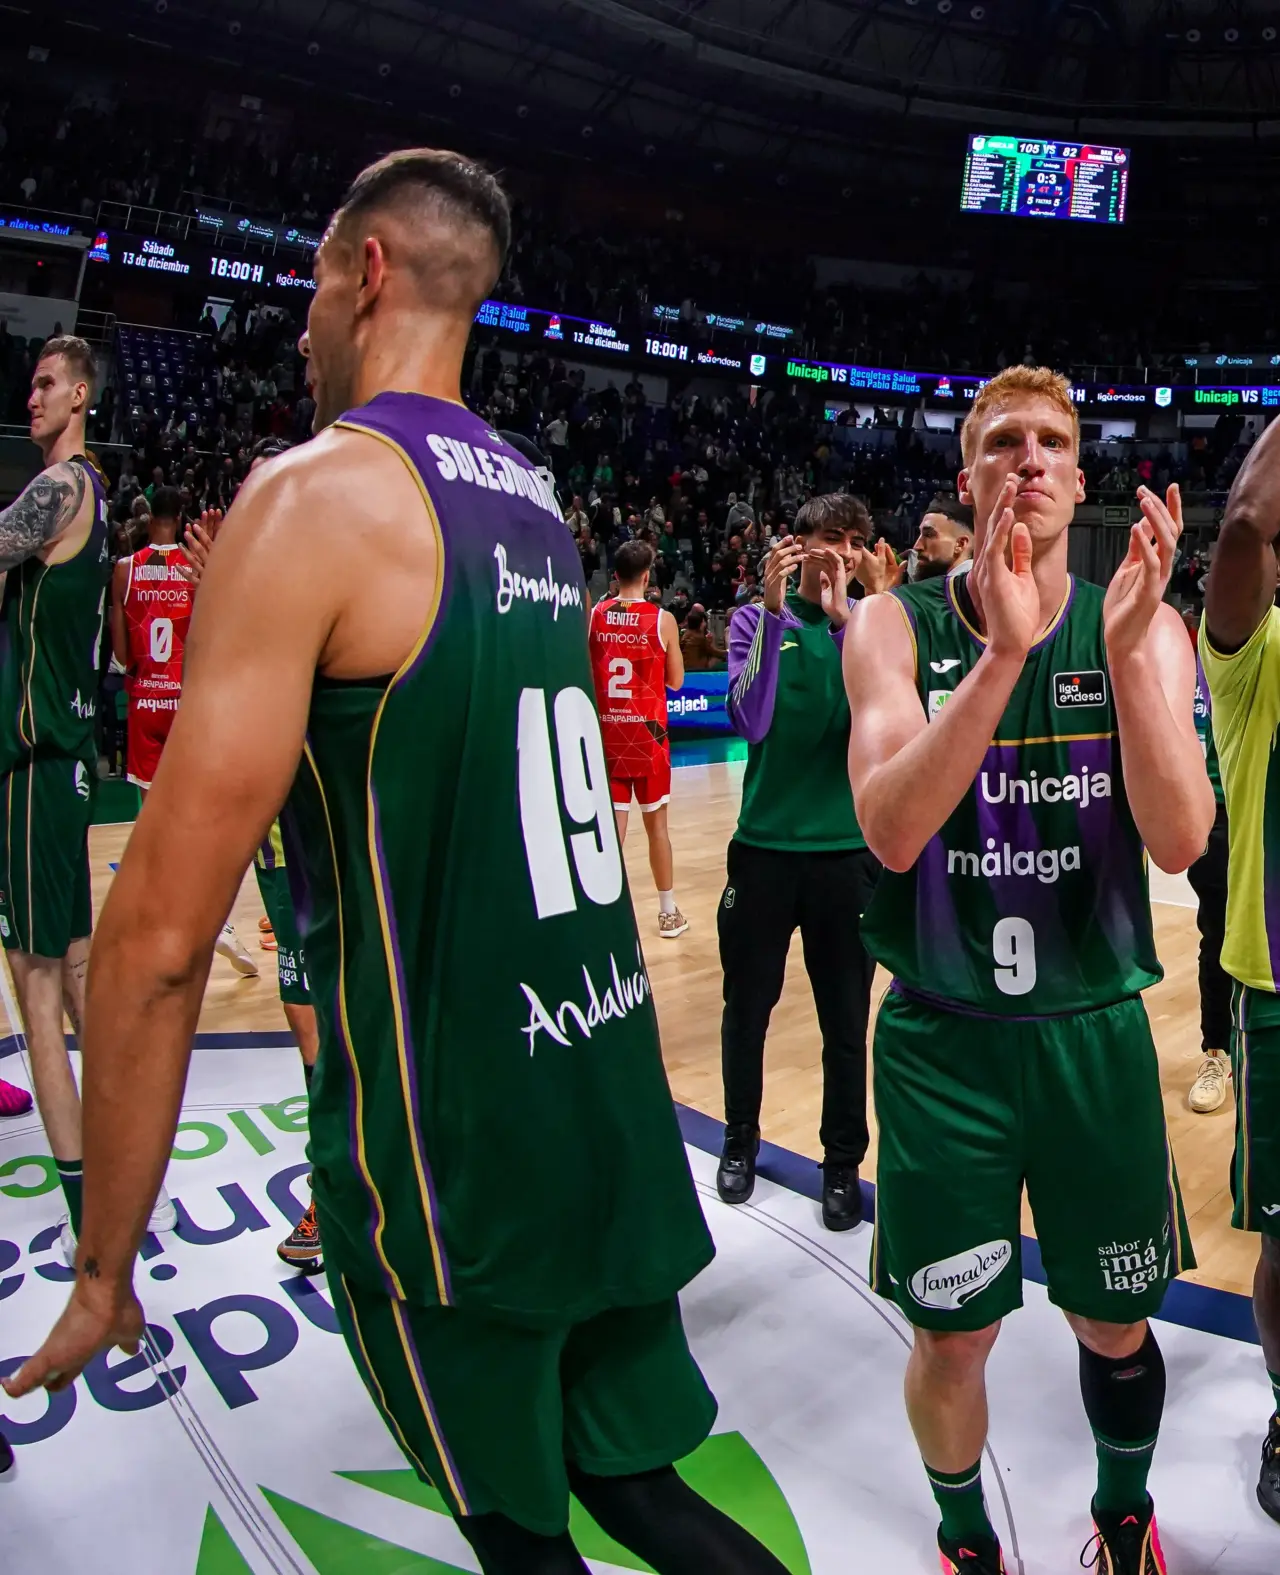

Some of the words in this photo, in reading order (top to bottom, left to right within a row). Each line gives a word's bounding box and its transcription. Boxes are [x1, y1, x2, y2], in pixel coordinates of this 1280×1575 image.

[1020, 143, 1040, 154] 105
[1042, 144, 1056, 154] VS
[1062, 147, 1078, 157] 82
[1037, 172, 1056, 184] 0:3
[1026, 196, 1034, 204] 5
[142, 240, 174, 256] Sábado
[122, 252, 134, 264] 13
[135, 255, 146, 267] de
[148, 257, 190, 274] diciembre
[210, 257, 250, 280] 18:00
[252, 265, 263, 282] H
[502, 306, 527, 320] Salud
[500, 316, 530, 332] Burgos
[589, 323, 616, 337] Sábado
[573, 332, 583, 343] 13
[584, 334, 593, 345] de
[594, 335, 629, 352] diciembre
[646, 338, 677, 356] 18:00
[679, 346, 688, 360] H
[1228, 357, 1253, 365] Unicaja
[786, 362, 829, 383] Unicaja
[831, 368, 848, 382] VS
[851, 368, 891, 381] Recoletas
[893, 373, 916, 384] Salud
[850, 377, 865, 388] San
[867, 379, 889, 390] Pablo
[892, 381, 920, 394] Burgos
[964, 389, 973, 398] 13
[1076, 389, 1086, 402] H
[1195, 390, 1239, 406] Unicaja
[1241, 390, 1258, 402] VS
[1262, 396, 1277, 405] San
[137, 588, 188, 602] inmoovs
[606, 611, 640, 626] BENITEZ
[150, 617, 173, 662] 0
[608, 658, 633, 699] 2
[1059, 683, 1079, 694] liga
[1060, 692, 1102, 703] endesa
[980, 765, 1112, 808] Unicaja
[517, 686, 623, 919] 19
[947, 838, 1080, 884] málaga
[992, 916, 1037, 995] 9
[1098, 1240, 1141, 1255] sabor
[1111, 1238, 1159, 1273] má
[920, 1243, 1008, 1298] famadesa
[1102, 1267, 1159, 1294] laga
